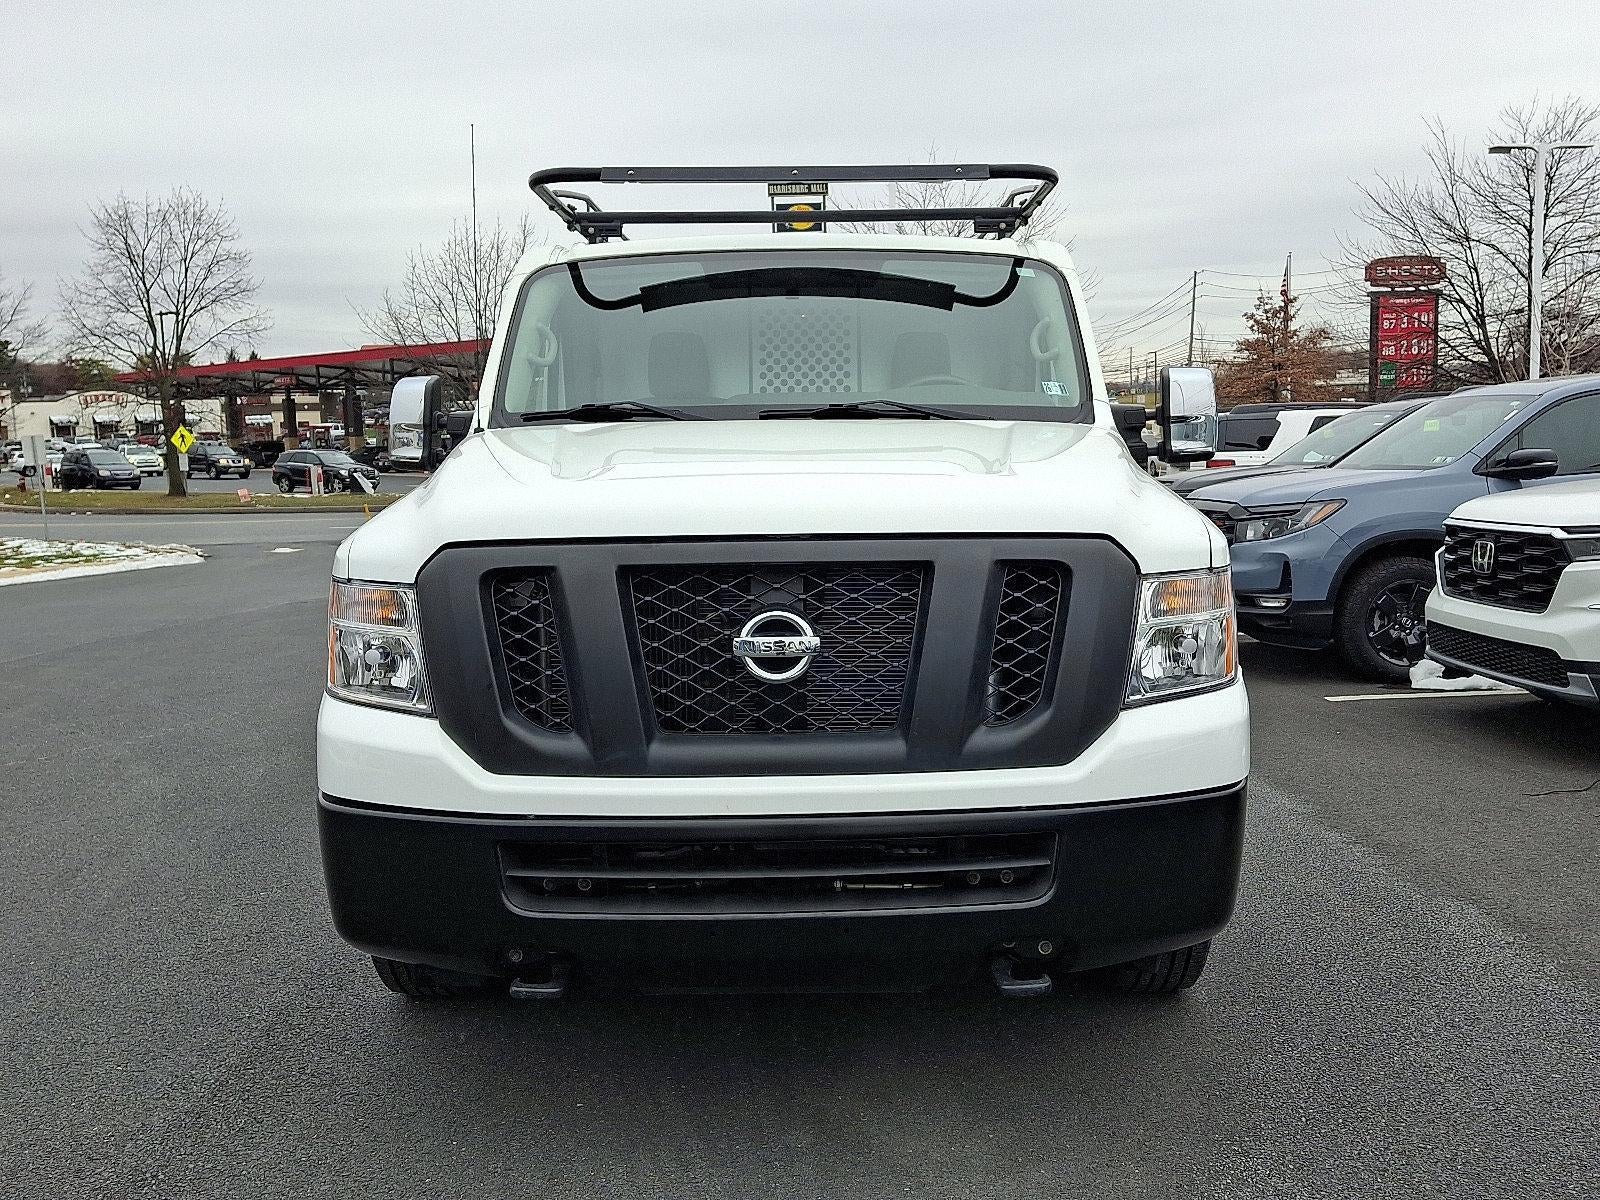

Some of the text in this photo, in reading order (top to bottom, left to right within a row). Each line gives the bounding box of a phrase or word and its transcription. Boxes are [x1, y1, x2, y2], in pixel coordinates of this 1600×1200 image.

[769, 184, 827, 194] HARRISBURG MALL
[1376, 265, 1439, 277] SHEETZ
[1383, 319, 1396, 329] 87
[738, 640, 812, 653] NISSAN
